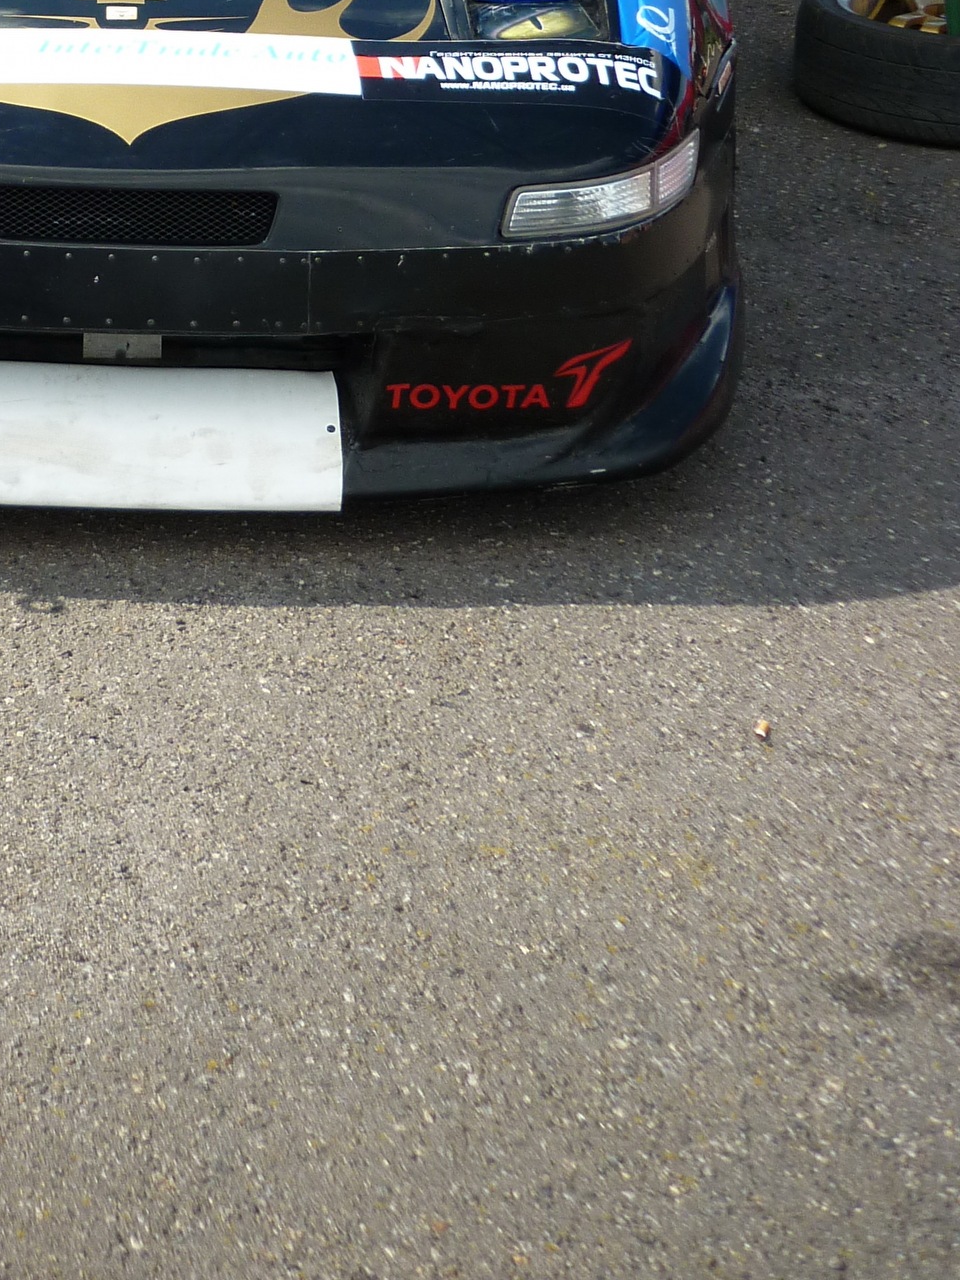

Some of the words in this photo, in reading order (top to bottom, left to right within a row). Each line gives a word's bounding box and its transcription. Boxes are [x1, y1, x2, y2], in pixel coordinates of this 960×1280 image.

[614, 53, 656, 69] износа
[377, 56, 664, 100] NANOPROTEC
[386, 383, 551, 410] TOYOTA
